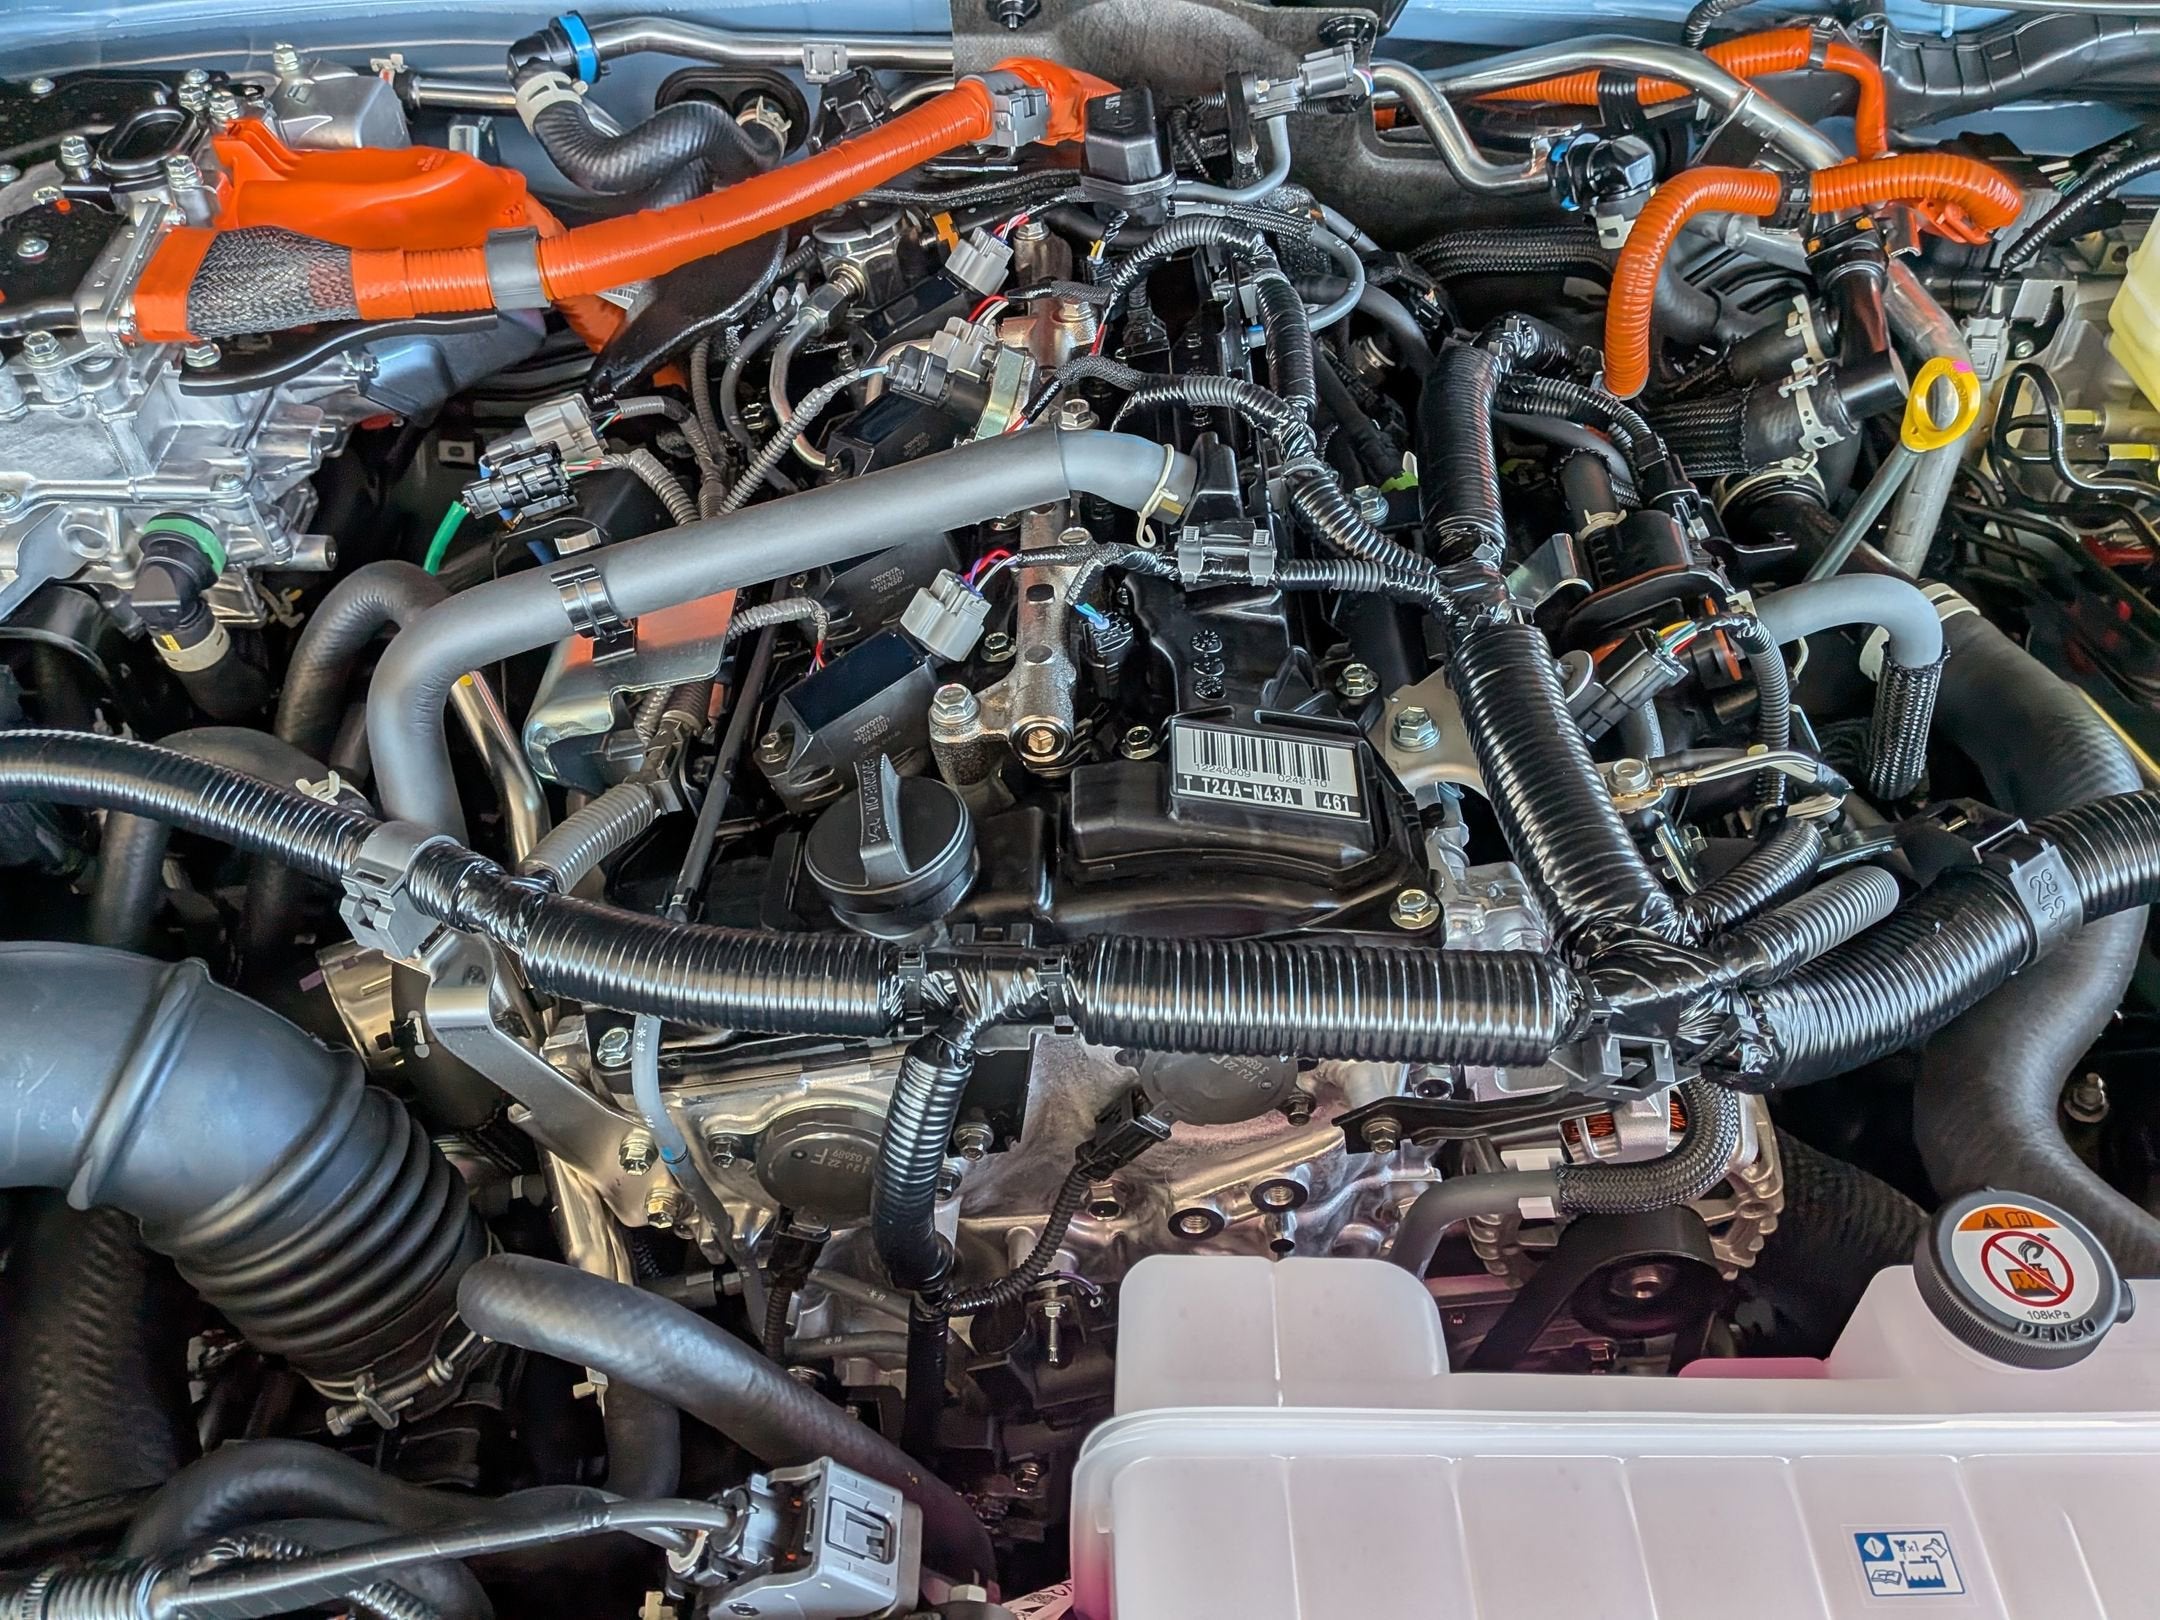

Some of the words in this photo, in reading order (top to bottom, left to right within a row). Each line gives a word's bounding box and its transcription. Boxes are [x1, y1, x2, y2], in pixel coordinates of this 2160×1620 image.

[870, 566, 900, 584] TOYOTA
[878, 576, 903, 593] DENSO
[853, 714, 885, 735] TOYOTA
[862, 724, 888, 745] DENSO
[1195, 763, 1251, 778] 12240609
[1277, 775, 1328, 788] 0248110
[1183, 775, 1193, 791] T
[1201, 777, 1295, 805] T24A-N43A
[1321, 794, 1350, 813] 461
[2029, 868, 2058, 906] 28
[810, 1147, 829, 1165] F
[2026, 1309, 2071, 1320] 108kPa
[2017, 1317, 2097, 1342] DENSO
